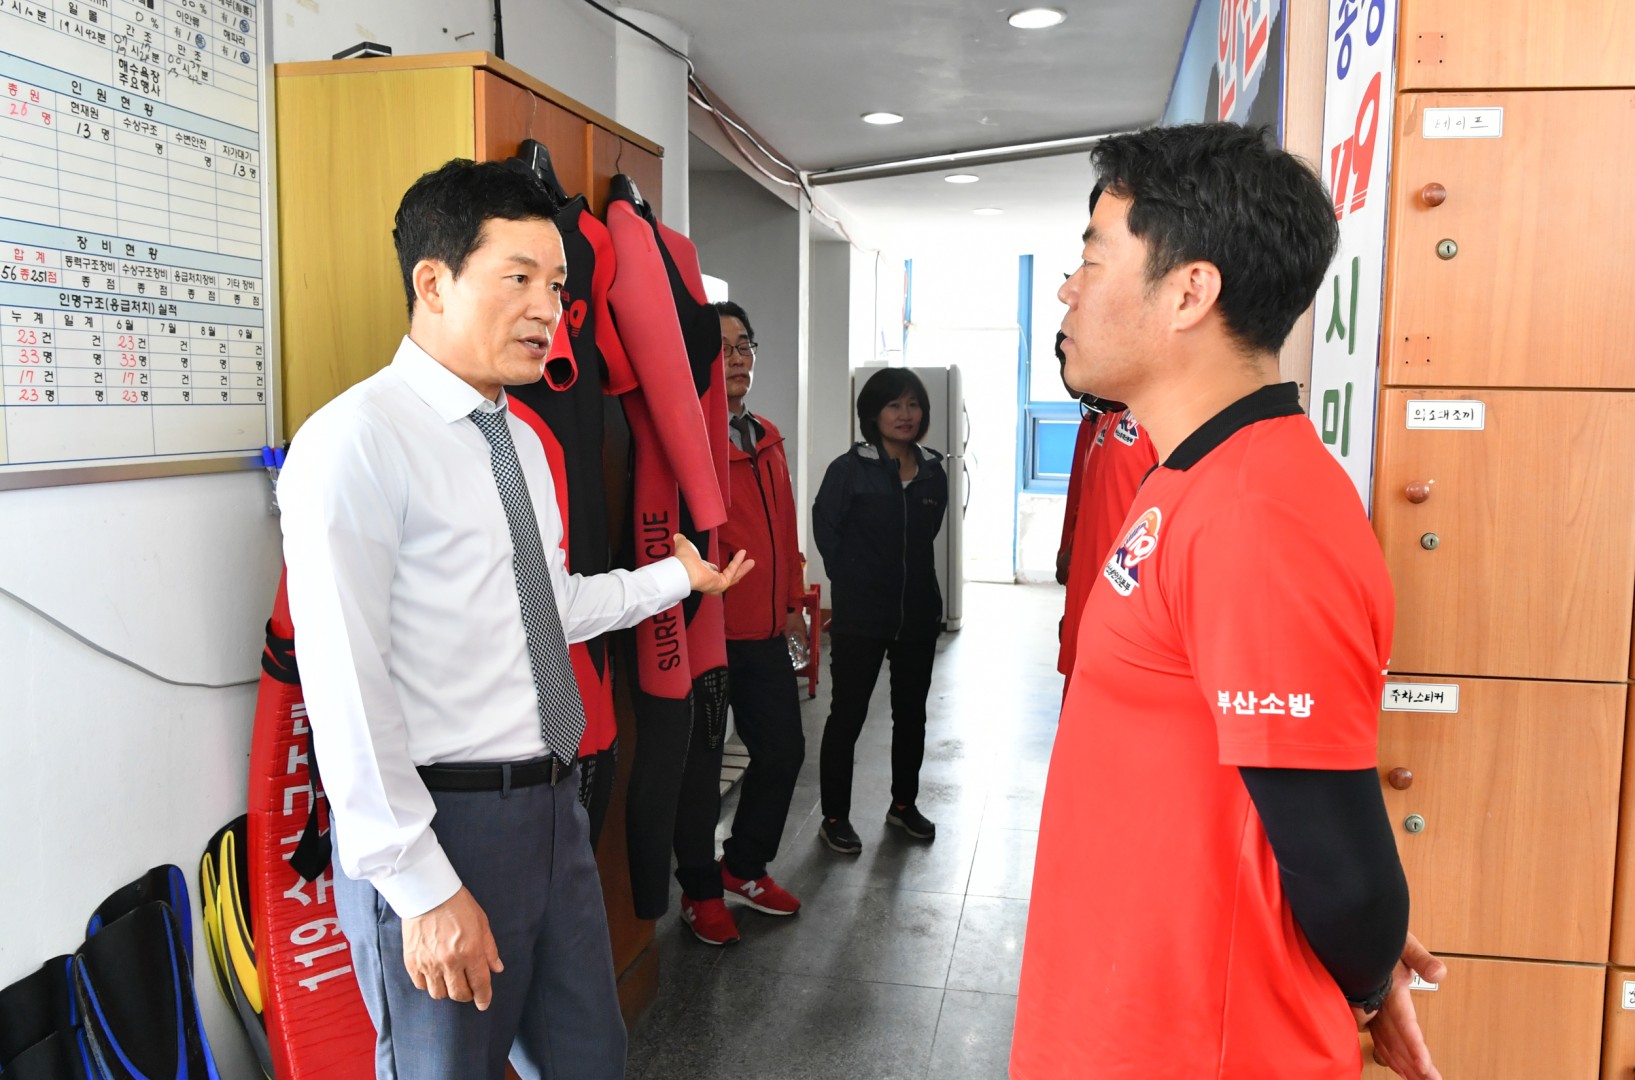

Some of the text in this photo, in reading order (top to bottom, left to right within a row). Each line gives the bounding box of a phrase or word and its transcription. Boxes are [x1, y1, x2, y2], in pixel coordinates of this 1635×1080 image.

[71, 101, 99, 119] 현재원
[123, 118, 157, 136] 수상구조
[176, 132, 207, 150] 수변안전
[1331, 72, 1381, 221] 119
[65, 256, 115, 273] 동력구조장비
[122, 264, 168, 280] 수상구조장비
[175, 271, 216, 286] 응급처치장비
[159, 304, 177, 316] 실적
[92, 335, 100, 346] 건
[93, 354, 101, 365] 명
[95, 372, 102, 383] 건
[95, 391, 103, 402] 명
[643, 510, 671, 559] CUE
[1217, 690, 1315, 718] 부산소방
[1391, 688, 1444, 704] 주차스티커
